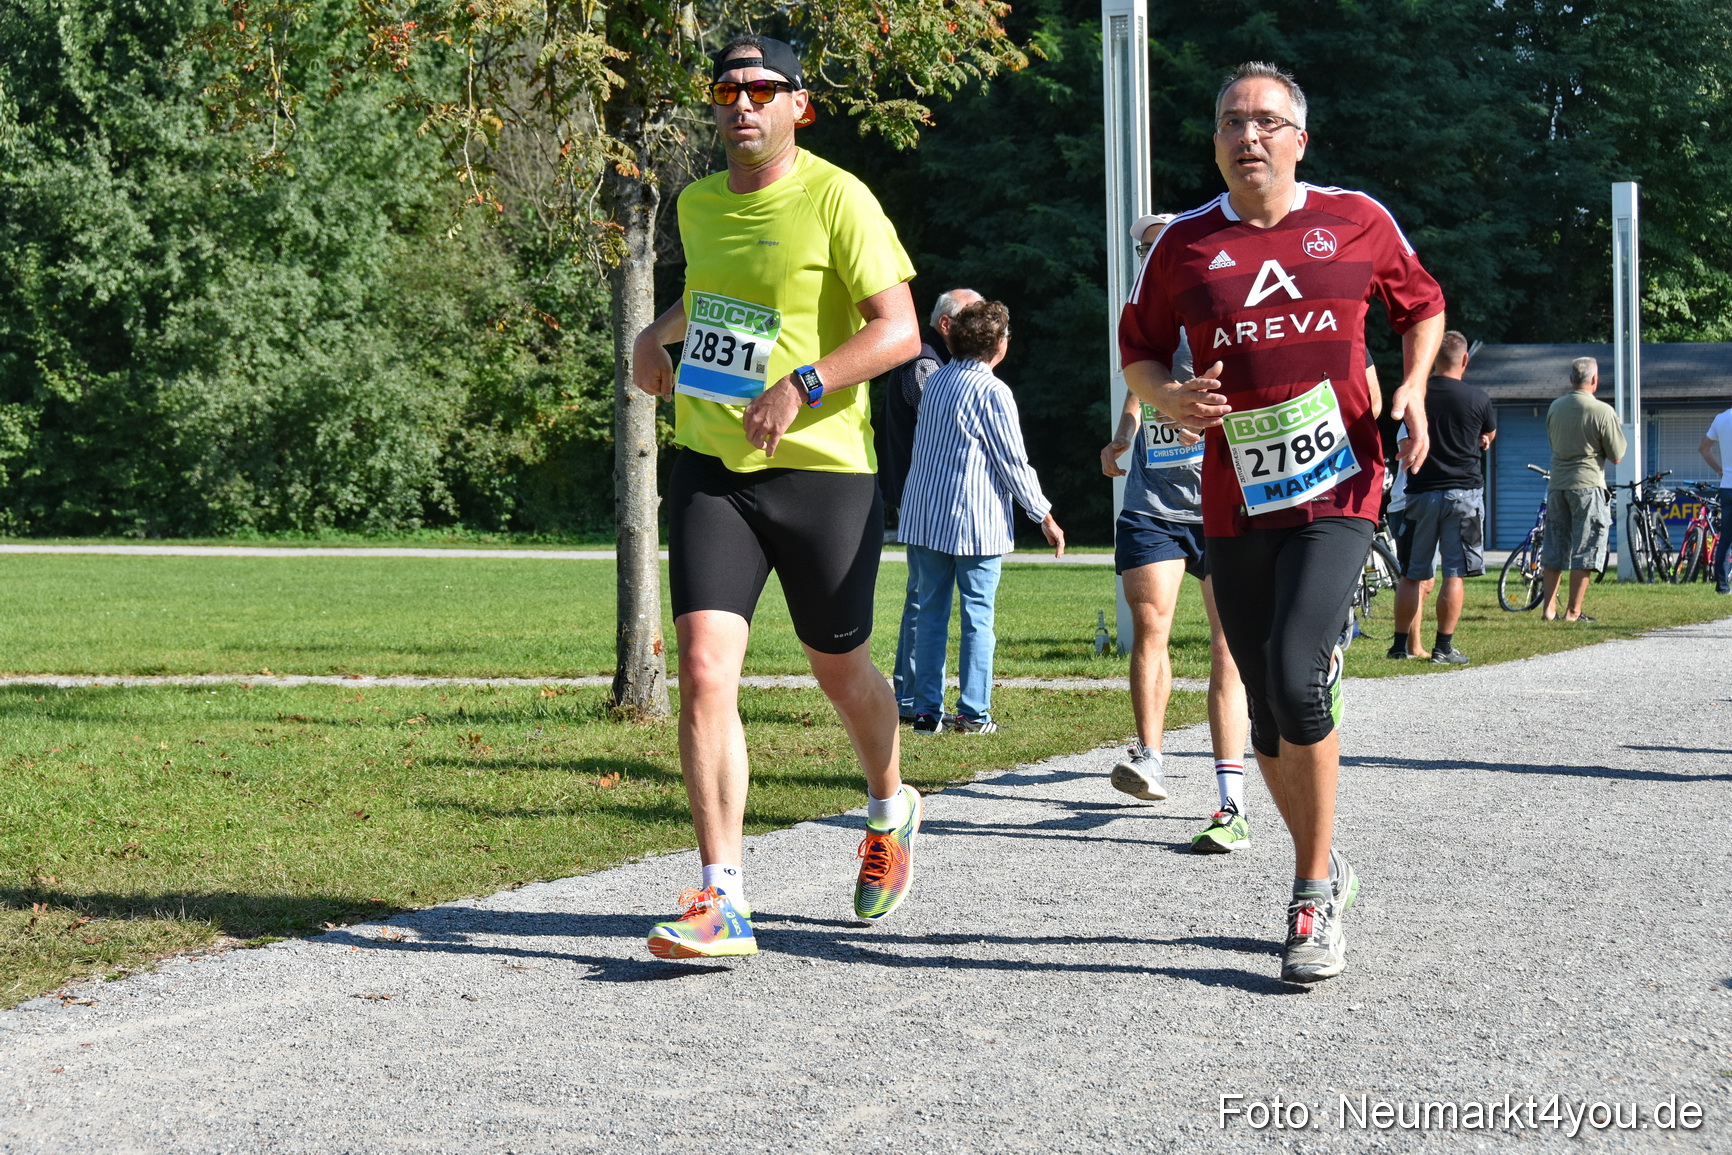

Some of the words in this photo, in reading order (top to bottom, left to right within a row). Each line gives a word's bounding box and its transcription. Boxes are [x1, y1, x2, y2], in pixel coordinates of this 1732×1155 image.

[1208, 260, 1236, 270] adidas
[1306, 240, 1334, 252] FCN
[696, 296, 772, 333] BOCK
[1212, 309, 1338, 349] AREVA
[690, 329, 757, 371] 2831
[1231, 390, 1329, 440] BOCK
[1153, 442, 1205, 458] CHRISTOPHE
[1244, 420, 1336, 478] 2786
[1263, 453, 1343, 501] MAREK
